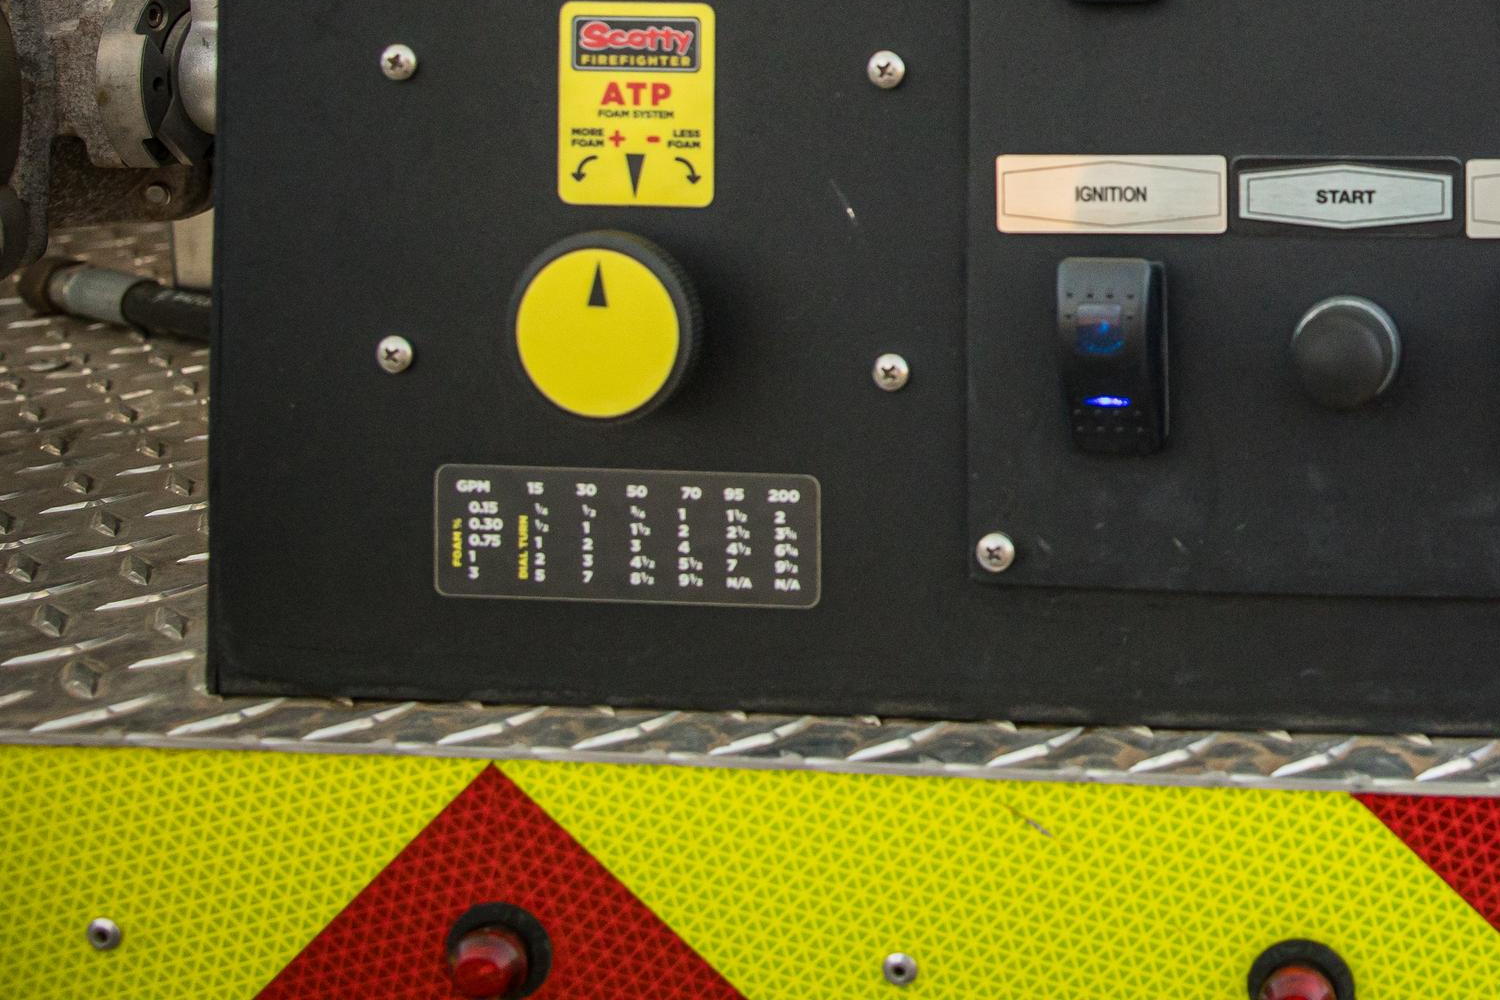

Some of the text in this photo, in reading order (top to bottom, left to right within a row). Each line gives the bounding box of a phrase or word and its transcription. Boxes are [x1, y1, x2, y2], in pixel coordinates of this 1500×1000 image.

[578, 20, 695, 56] Scotty
[580, 53, 692, 67] FIREFIGHTER
[600, 81, 673, 107] ATP
[597, 109, 675, 120] FOAM SYSTEM
[571, 128, 605, 138] MORE
[672, 129, 701, 138] LESS
[571, 138, 605, 148] FOAM
[667, 140, 701, 149] FOAM
[1074, 185, 1148, 203] IGNITION
[1315, 188, 1376, 205] START
[455, 479, 801, 503] GPM 15 30 50 70 95 200
[677, 507, 687, 521] 1
[774, 510, 786, 525] 2
[468, 517, 504, 531] 0.30
[582, 521, 591, 534] 1
[677, 524, 690, 538] 2
[468, 533, 502, 548] 0.75
[534, 535, 543, 550] 1
[582, 537, 594, 551] 2
[630, 539, 642, 553] 3
[677, 540, 691, 555] 4
[468, 550, 477, 563] 1
[534, 552, 546, 566] 2
[582, 554, 594, 568] 3
[726, 558, 738, 572] 7
[468, 566, 480, 579] 3
[534, 568, 546, 582] 5
[582, 570, 595, 583] 7
[725, 576, 754, 590] N/A
[774, 577, 802, 592] N/A
